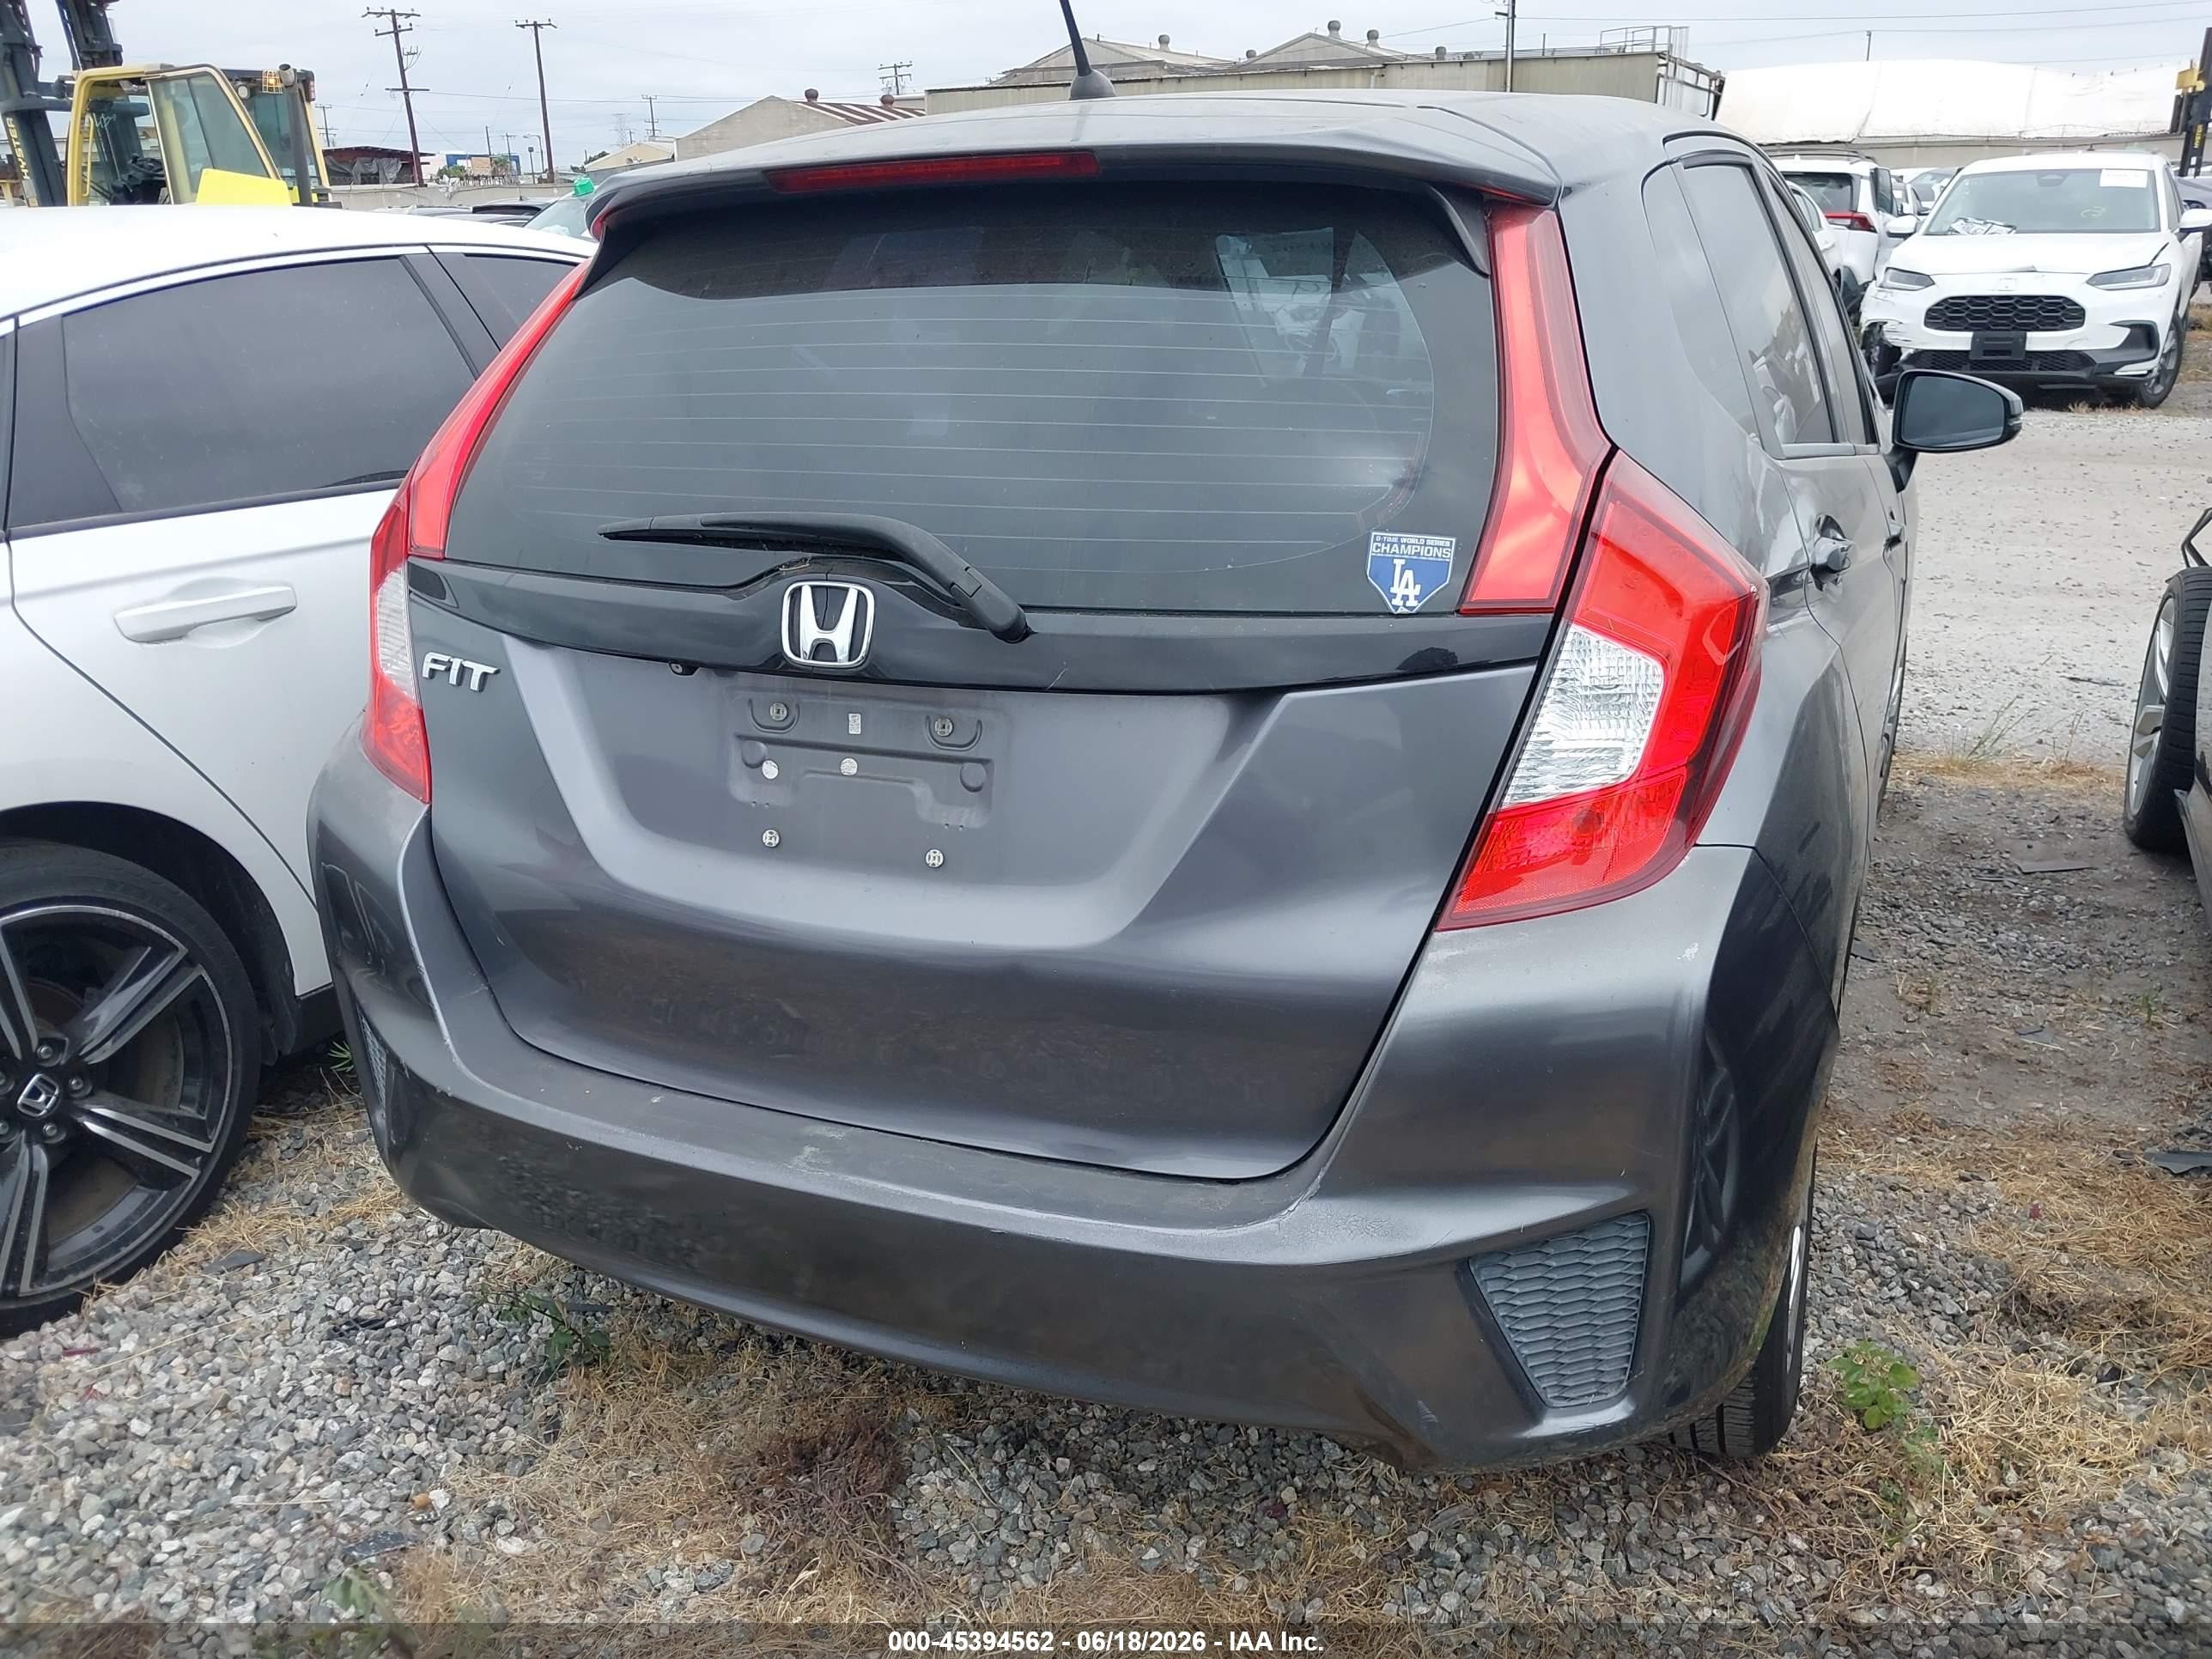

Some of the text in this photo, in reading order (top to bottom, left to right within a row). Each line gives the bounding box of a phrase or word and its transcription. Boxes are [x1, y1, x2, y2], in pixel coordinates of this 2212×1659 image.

[6, 118, 30, 179] HYSTER
[1371, 542, 1451, 558] CHAMPIONS
[1390, 558, 1421, 607] LA
[422, 652, 501, 693] FIT
